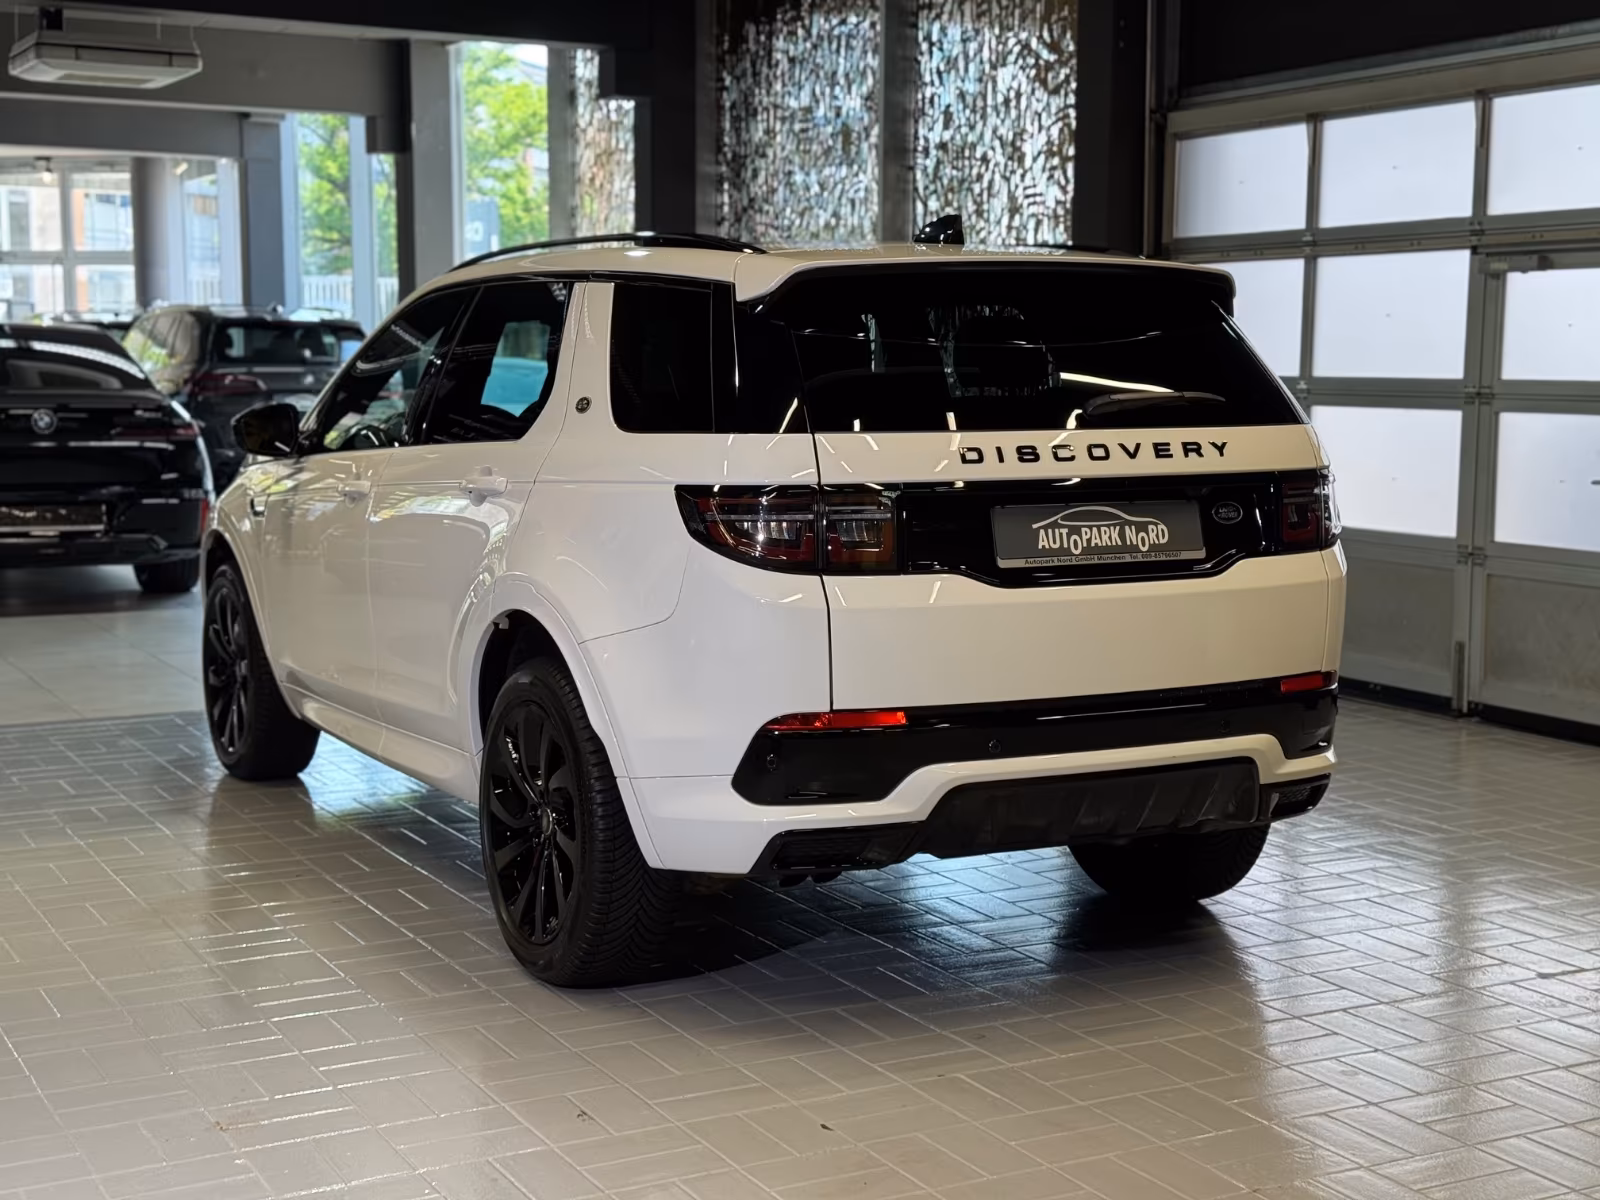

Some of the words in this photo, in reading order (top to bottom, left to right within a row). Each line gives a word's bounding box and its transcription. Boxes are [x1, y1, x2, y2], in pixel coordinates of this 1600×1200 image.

[959, 441, 1228, 465] DISCOVERY
[1038, 526, 1122, 555] AUTOPARK
[1125, 524, 1169, 552] NORD
[1024, 557, 1055, 566] Autopark
